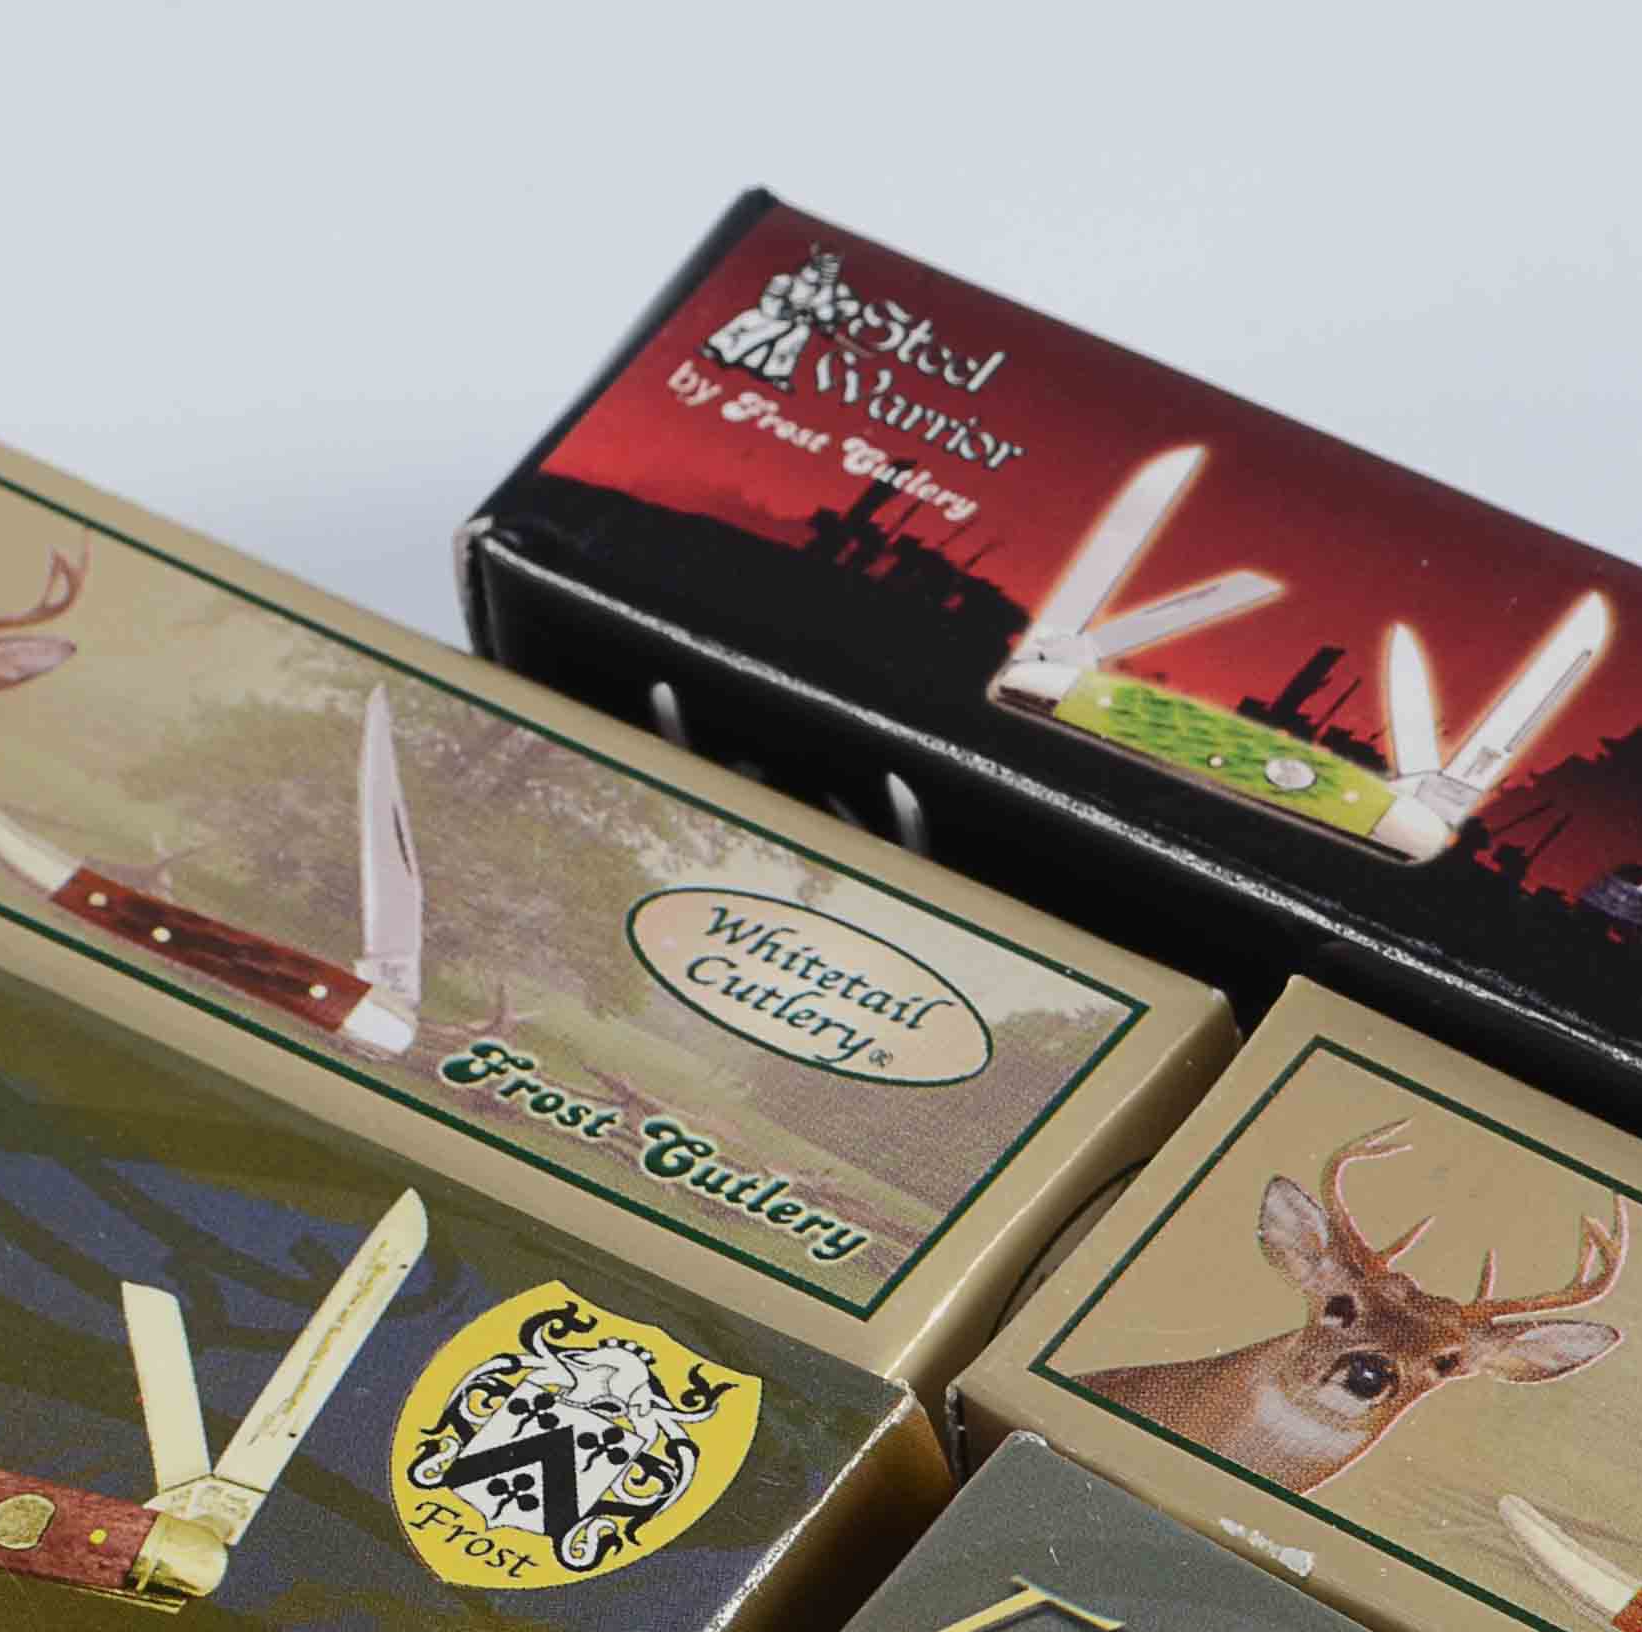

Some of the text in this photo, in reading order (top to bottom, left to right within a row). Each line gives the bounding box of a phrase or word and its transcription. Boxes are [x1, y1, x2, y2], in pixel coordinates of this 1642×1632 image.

[850, 300, 1006, 392] Steel
[668, 361, 979, 521] by Frost Cutlery
[816, 351, 1024, 470] Warrior
[705, 906, 955, 1030] Whitetail
[443, 1041, 867, 1261] Frost Cutlery
[409, 1501, 540, 1578] Frost
